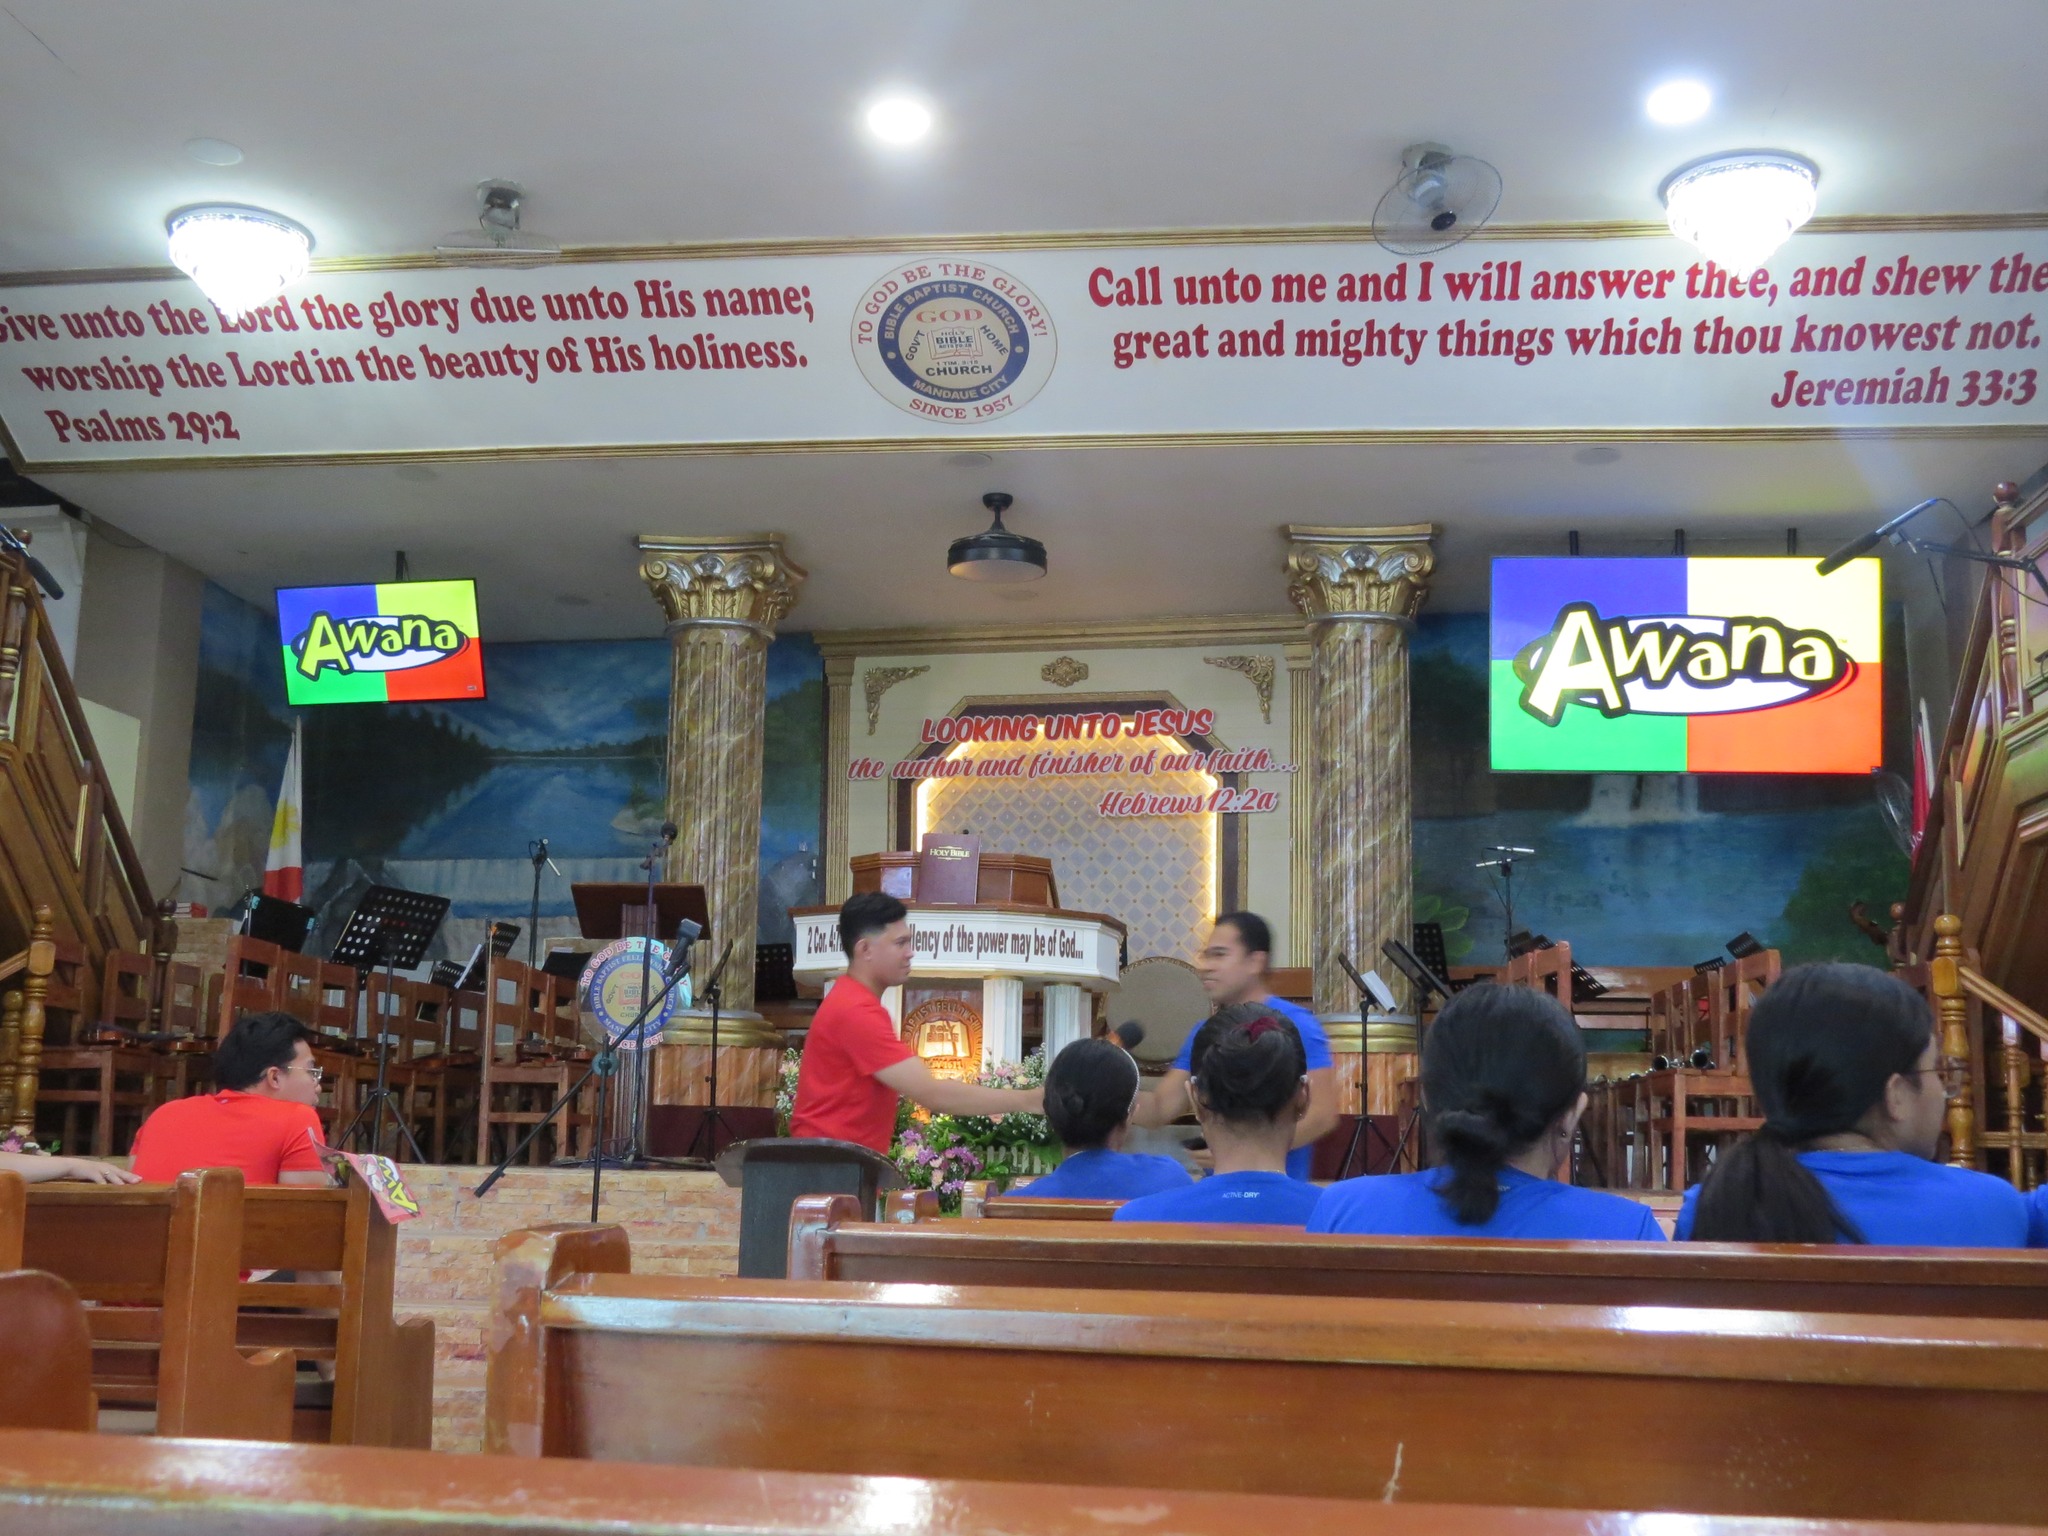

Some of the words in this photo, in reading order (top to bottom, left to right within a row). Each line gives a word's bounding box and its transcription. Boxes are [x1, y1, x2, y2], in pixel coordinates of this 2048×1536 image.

[901, 265, 932, 284] BE
[938, 263, 986, 281] THE
[1088, 266, 1163, 308] Call
[1173, 266, 1263, 306] unto
[1271, 273, 1327, 304] me
[1336, 263, 1408, 303] and
[1417, 261, 1435, 302] I
[1443, 260, 1522, 303] will
[1530, 266, 1676, 301] answer
[1685, 260, 1778, 308] thee,
[1789, 255, 1867, 298] and
[1871, 254, 1983, 297] shew
[0, 306, 59, 342] ive
[61, 305, 145, 339] unto
[147, 299, 209, 336] the
[208, 295, 299, 333] Lord
[301, 294, 363, 330] the
[371, 291, 459, 337] glory
[470, 287, 537, 324] due
[542, 287, 629, 321] unto
[634, 279, 697, 319] His
[703, 283, 814, 323] name;
[864, 279, 899, 315] GOD
[884, 302, 906, 340] BIBLE
[903, 283, 969, 306] BAPTIST
[972, 288, 1020, 335] CHURCH
[992, 277, 1048, 337] GLORY!
[858, 320, 873, 344] TO
[916, 308, 983, 323] GOD
[935, 335, 974, 344] BIBLE
[979, 324, 1009, 356] HOME
[1113, 323, 1209, 369] great
[1217, 319, 1285, 358] and
[1295, 318, 1429, 367] mighty
[1437, 319, 1555, 366] things
[1565, 317, 1682, 357] which
[1694, 316, 1784, 355] thou
[1790, 314, 1962, 354] knowest
[1966, 312, 2042, 352] not.
[20, 359, 165, 397] worship
[165, 353, 227, 388] the
[226, 350, 317, 387] Lord
[316, 349, 356, 384] in
[356, 345, 416, 383] the
[423, 342, 540, 385] beauty
[546, 335, 582, 374] of
[584, 336, 647, 374] His
[650, 333, 809, 372] holiness.
[925, 364, 993, 377] CHURCH
[912, 379, 979, 400] MANDAUE
[980, 374, 1009, 396] CITY
[1771, 366, 1949, 409] Jeremiah
[1955, 368, 2038, 408] 33:3
[909, 398, 967, 419] SINCE
[973, 394, 1015, 418] 1957
[44, 409, 166, 444] Psalms
[168, 410, 241, 445] 29:2
[298, 613, 460, 679] Awana
[1525, 607, 1838, 719] Awana
[921, 714, 1039, 743] LOOKING
[1045, 712, 1121, 741] UNTO
[1126, 708, 1215, 737] JESUS
[848, 756, 886, 780] the
[892, 754, 973, 778] author
[976, 753, 1027, 777] and
[1028, 748, 1126, 780] finisher
[1129, 748, 1157, 776] of
[1160, 751, 1206, 773] our
[1205, 746, 1300, 775] faith...
[1099, 789, 1205, 817] Hebrews
[1206, 787, 1279, 812] 12:2a
[807, 926, 813, 954] 2
[813, 925, 828, 953] Cor.
[943, 924, 954, 953] of
[956, 925, 974, 954] the
[976, 930, 1009, 960] power
[1011, 932, 1031, 962] may
[1034, 927, 1046, 956] be
[1047, 929, 1057, 957] of
[1059, 929, 1084, 960] God...
[580, 969, 594, 986] TO
[590, 946, 614, 969] GOD
[616, 941, 632, 953] BE
[636, 940, 661, 954] TE
[643, 1031, 663, 1048] 957
